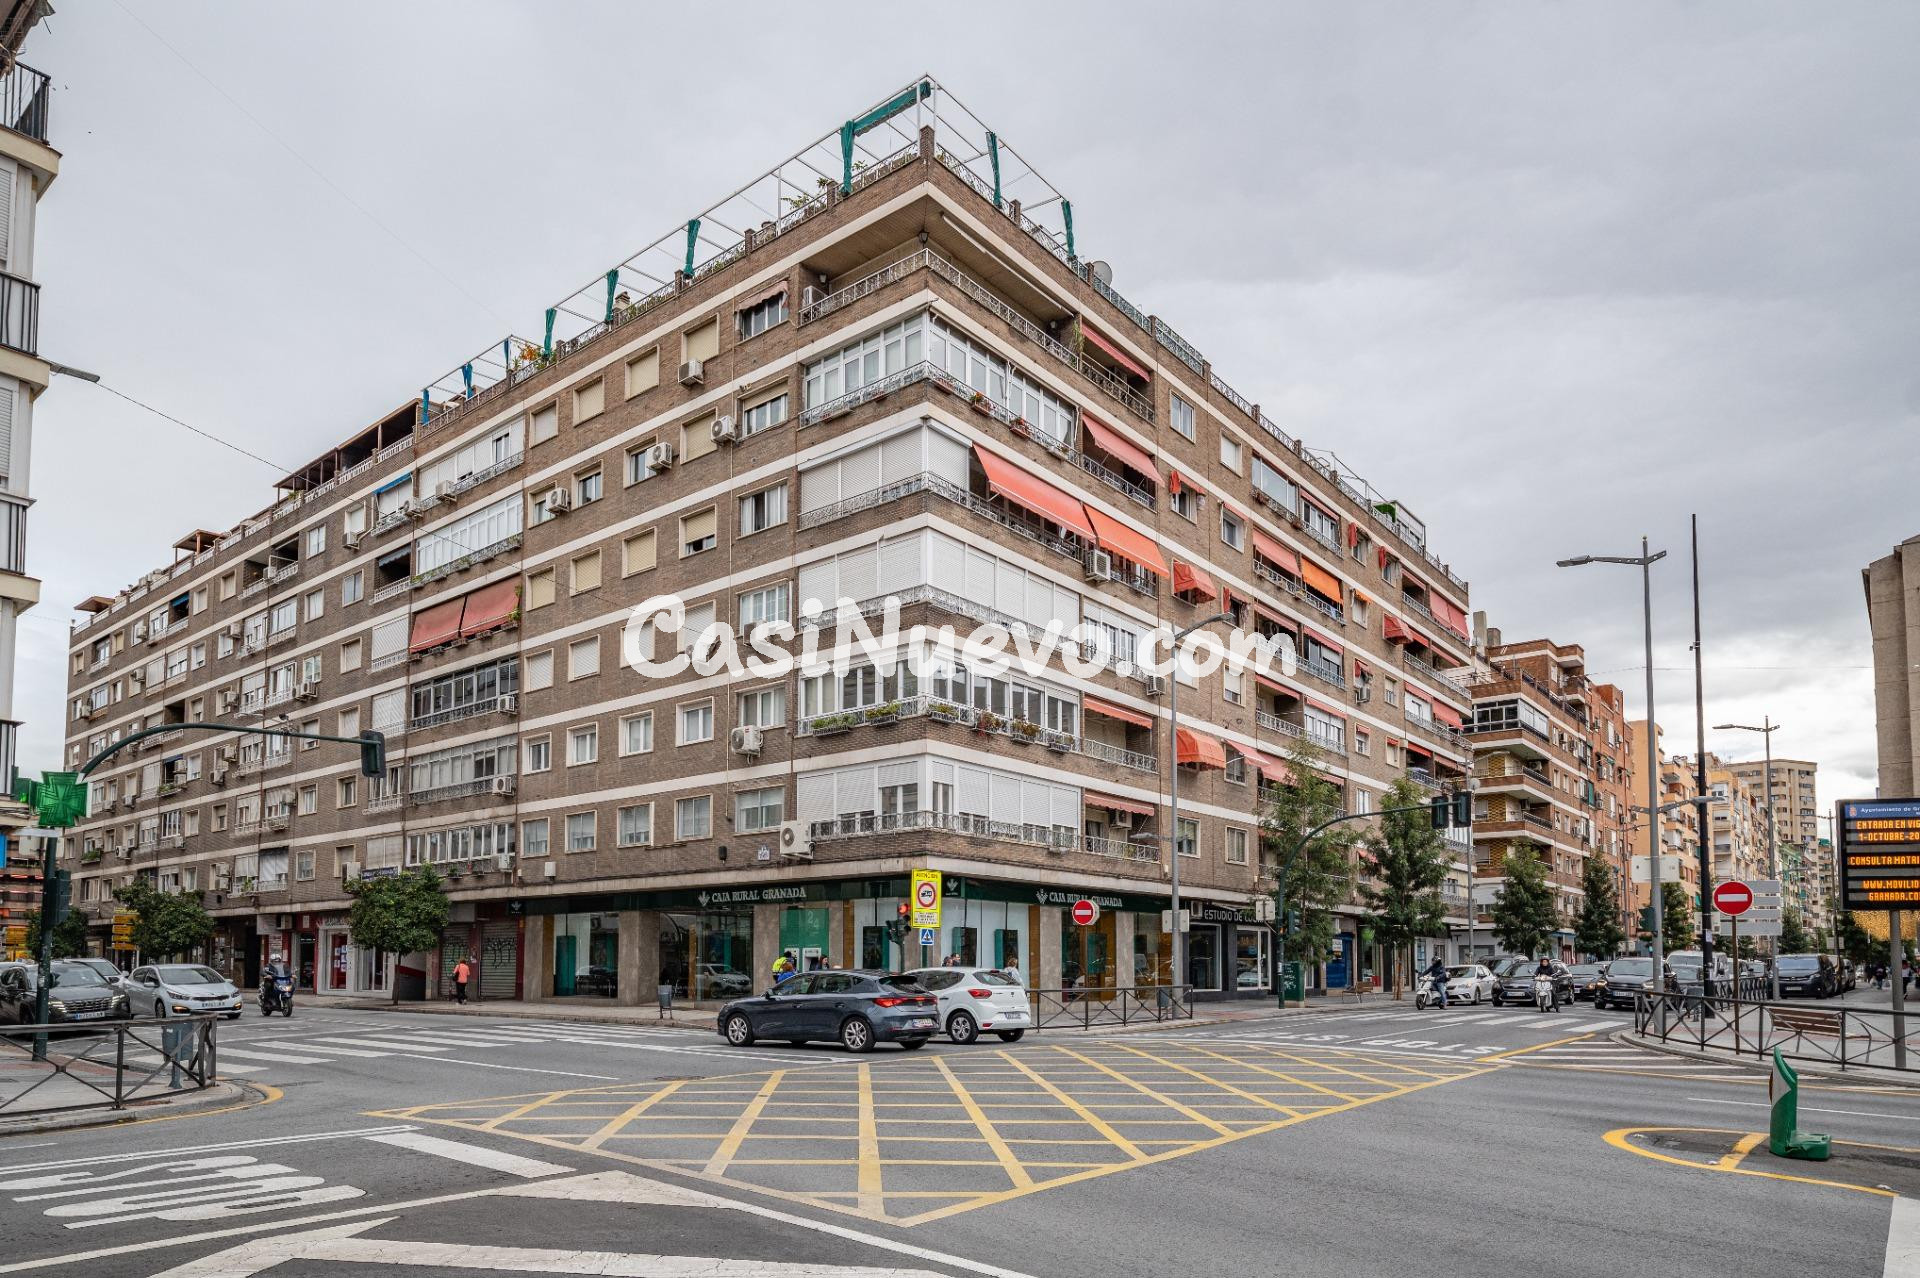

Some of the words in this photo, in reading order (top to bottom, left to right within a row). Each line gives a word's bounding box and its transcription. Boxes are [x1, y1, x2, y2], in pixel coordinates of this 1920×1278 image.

[1856, 820, 1894, 830] ENTRADA
[1895, 820, 1906, 829] EN
[1850, 856, 1893, 865] CONSULTA
[711, 891, 730, 902] CAJA
[732, 890, 760, 901] RURAL
[762, 887, 806, 899] GRANADA
[1049, 891, 1066, 903] CAJA
[1204, 909, 1232, 921] ESTUDIO
[1233, 911, 1243, 922] DE
